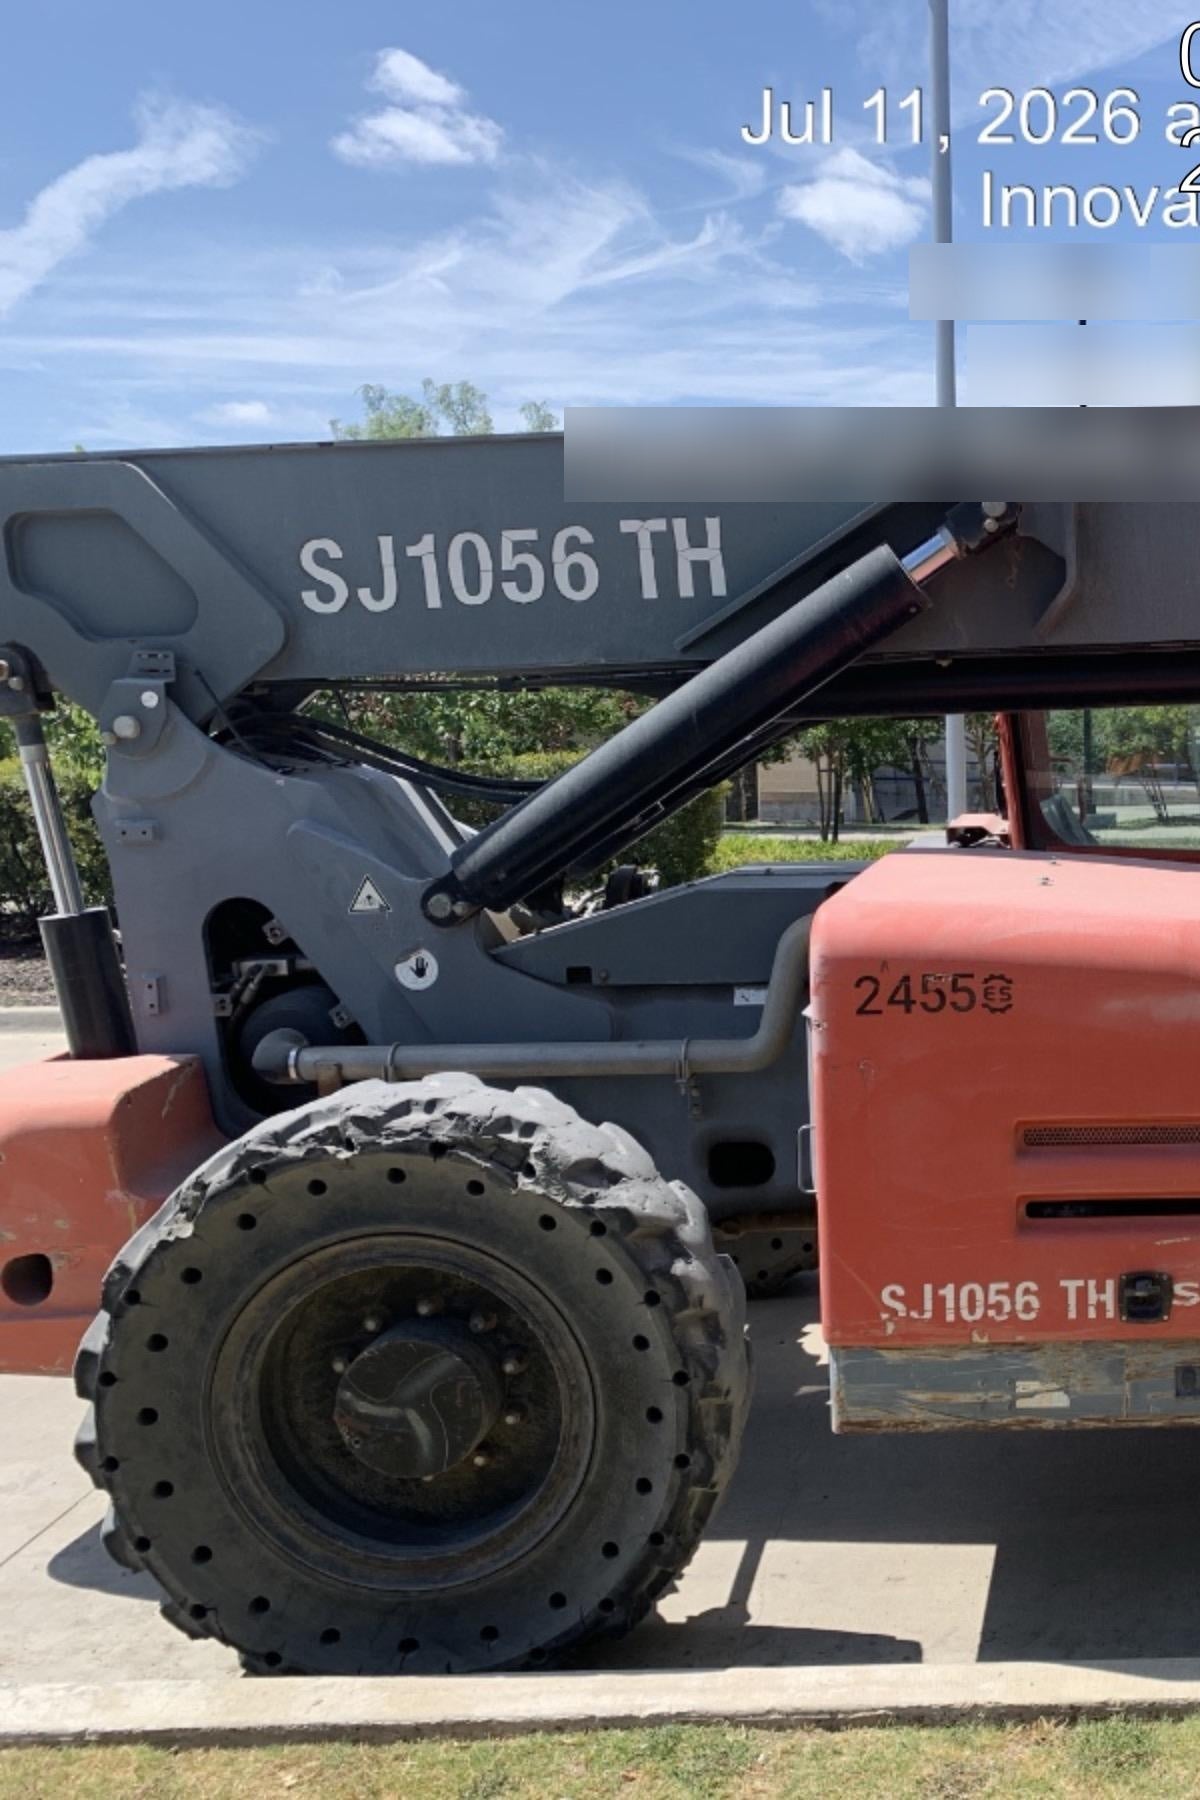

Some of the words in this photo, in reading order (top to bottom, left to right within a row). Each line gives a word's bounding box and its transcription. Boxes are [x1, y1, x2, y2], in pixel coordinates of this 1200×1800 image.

[300, 525, 599, 613] SJ1056
[619, 517, 727, 599] TH
[854, 973, 977, 1015] 2455
[880, 1281, 1040, 1323] SJ1056
[1059, 1279, 1115, 1320] TH
